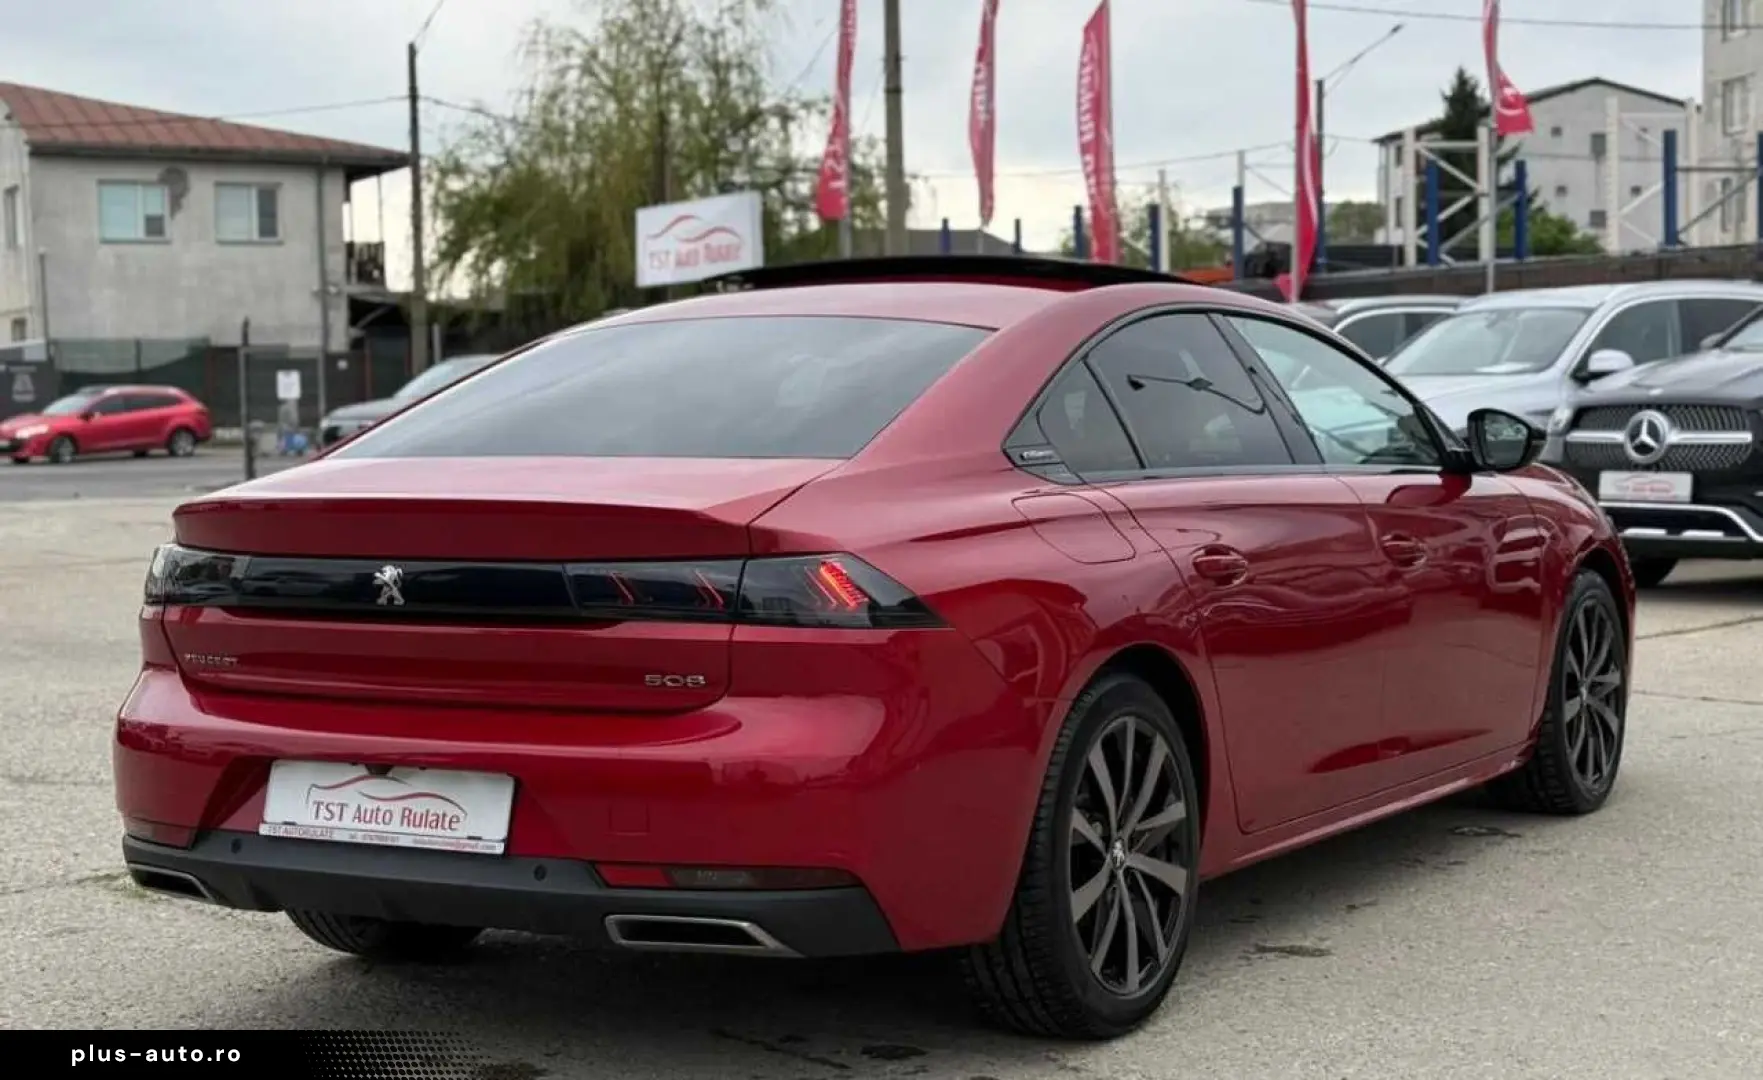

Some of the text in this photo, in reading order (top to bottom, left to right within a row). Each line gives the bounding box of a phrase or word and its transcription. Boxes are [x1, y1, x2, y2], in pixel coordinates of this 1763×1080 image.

[644, 674, 706, 688] 508
[312, 800, 461, 832] TST Auto Rulate
